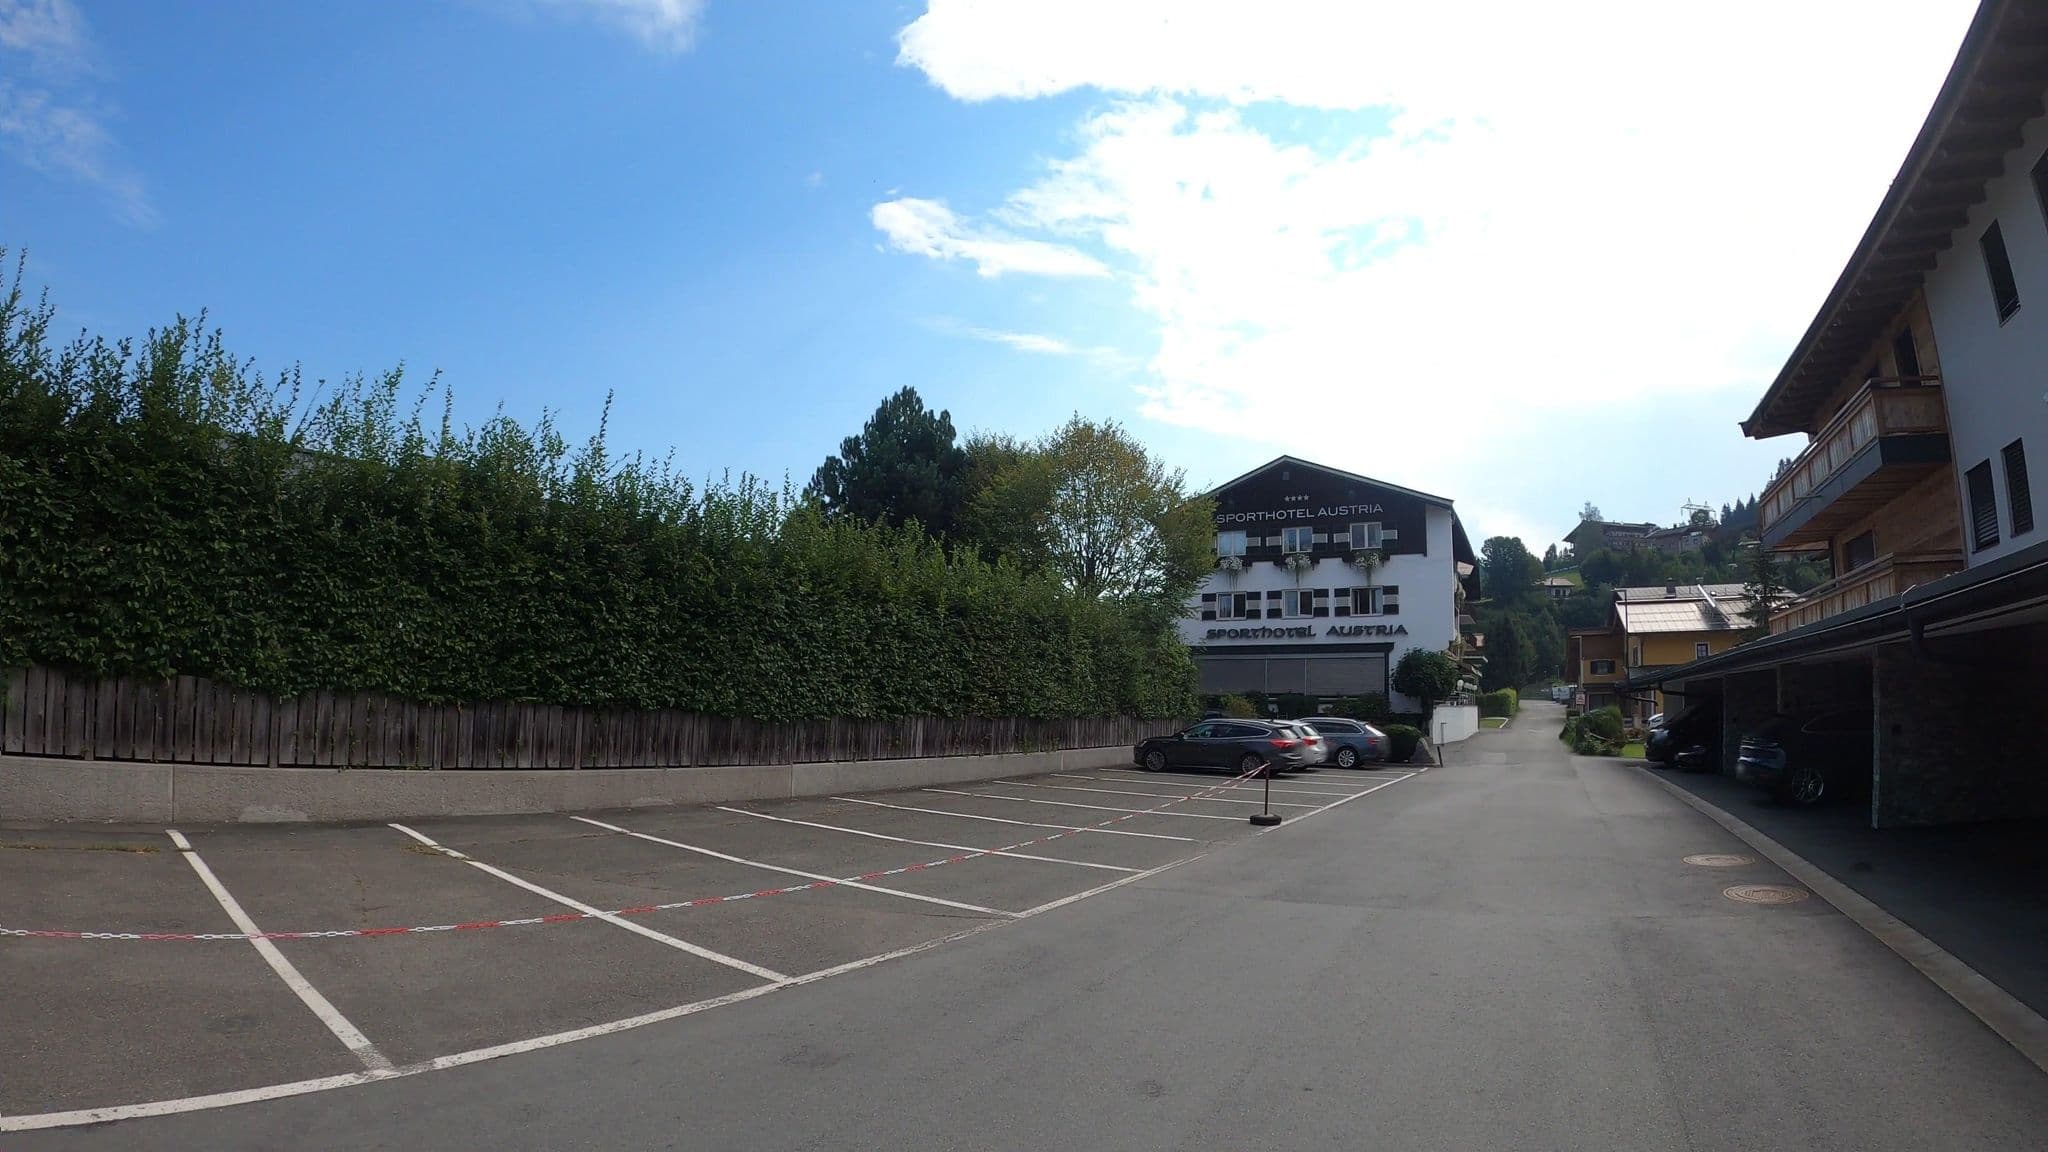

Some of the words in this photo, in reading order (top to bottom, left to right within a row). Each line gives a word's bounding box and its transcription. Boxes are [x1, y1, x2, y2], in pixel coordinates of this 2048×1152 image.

[1216, 508, 1315, 524] SPORTHOTEL
[1317, 503, 1384, 517] AUSTRIA
[1326, 624, 1409, 638] AUSTRIA
